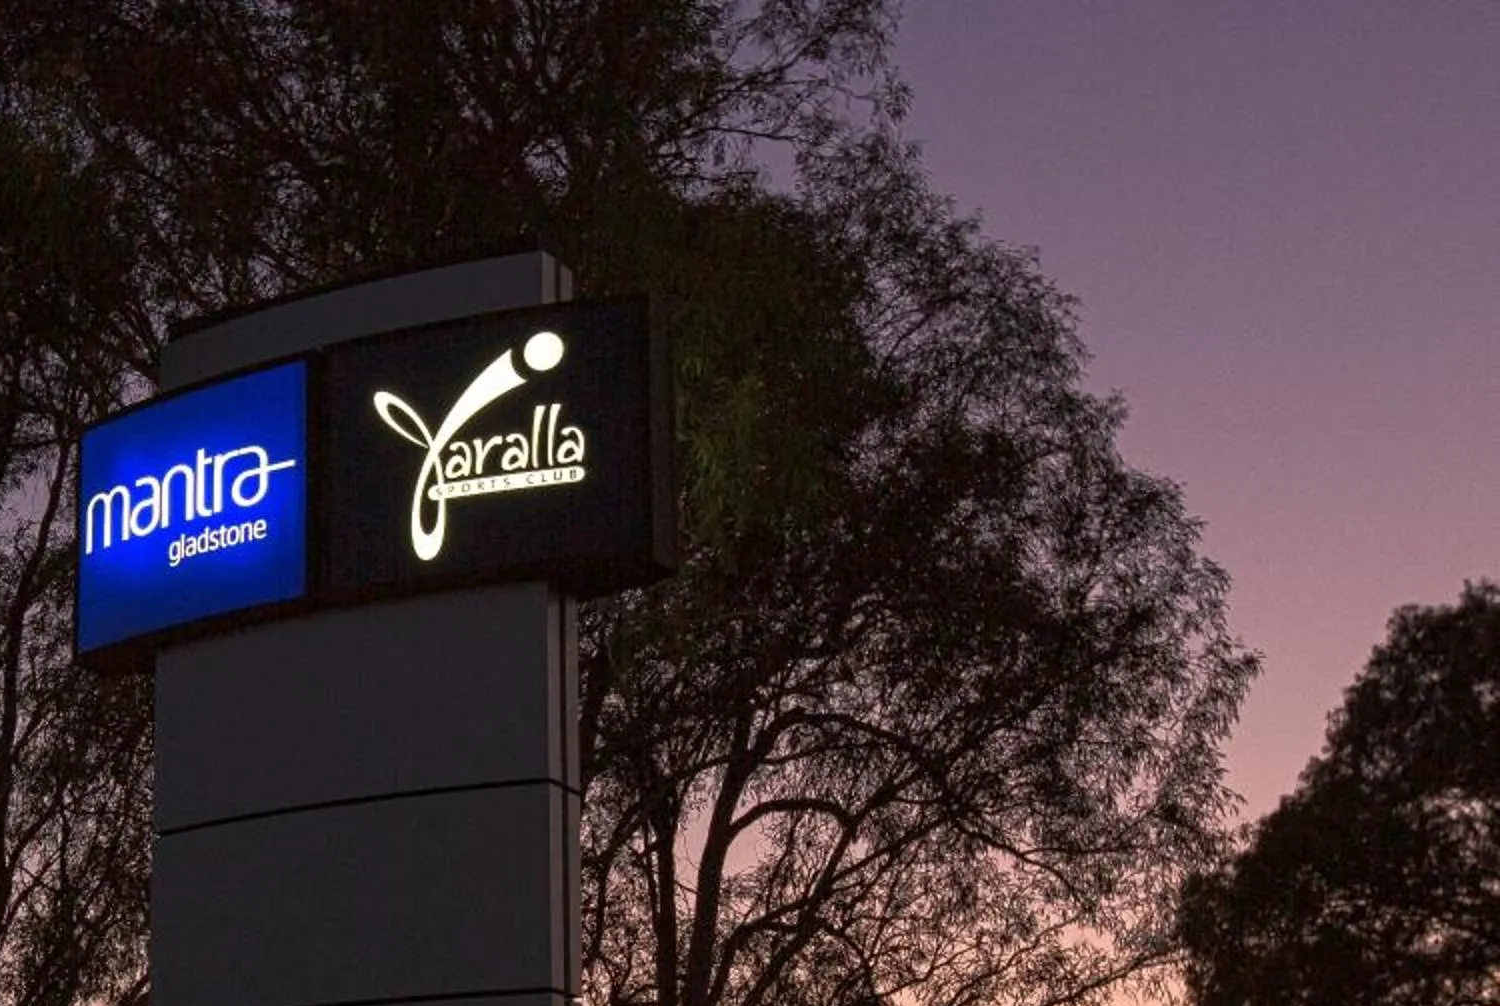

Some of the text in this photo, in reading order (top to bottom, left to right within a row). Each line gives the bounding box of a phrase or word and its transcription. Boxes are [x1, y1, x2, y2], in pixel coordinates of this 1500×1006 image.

[373, 347, 585, 561] Yaralla
[435, 469, 578, 496] SPORTS CLUB
[85, 445, 295, 554] mantra
[168, 519, 267, 566] gladstone
